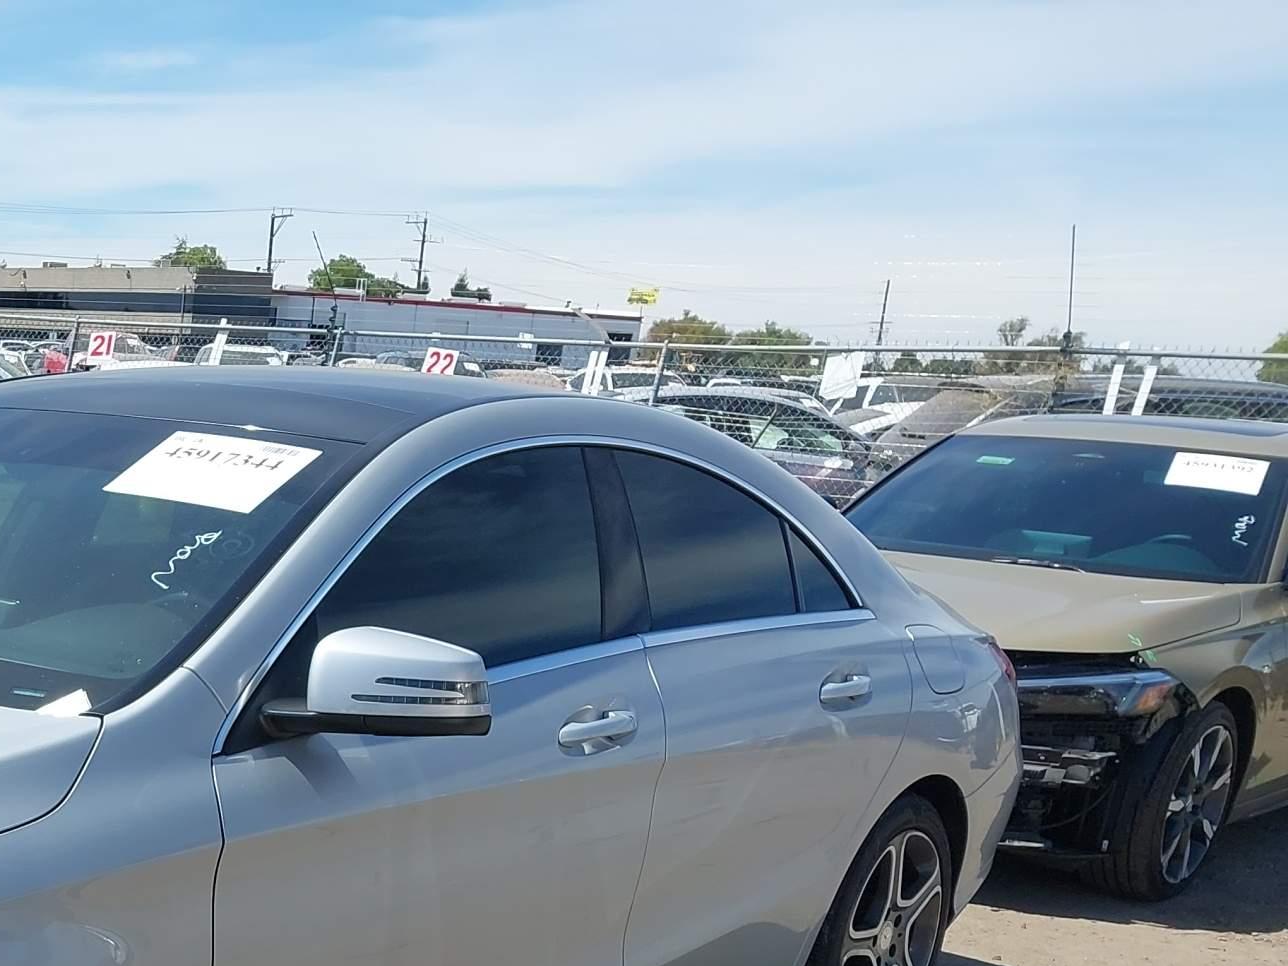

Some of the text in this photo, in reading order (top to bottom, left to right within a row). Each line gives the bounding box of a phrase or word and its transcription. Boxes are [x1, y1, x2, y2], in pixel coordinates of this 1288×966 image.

[90, 334, 113, 356] 21
[426, 351, 454, 374] 22
[165, 447, 284, 470] 45917344
